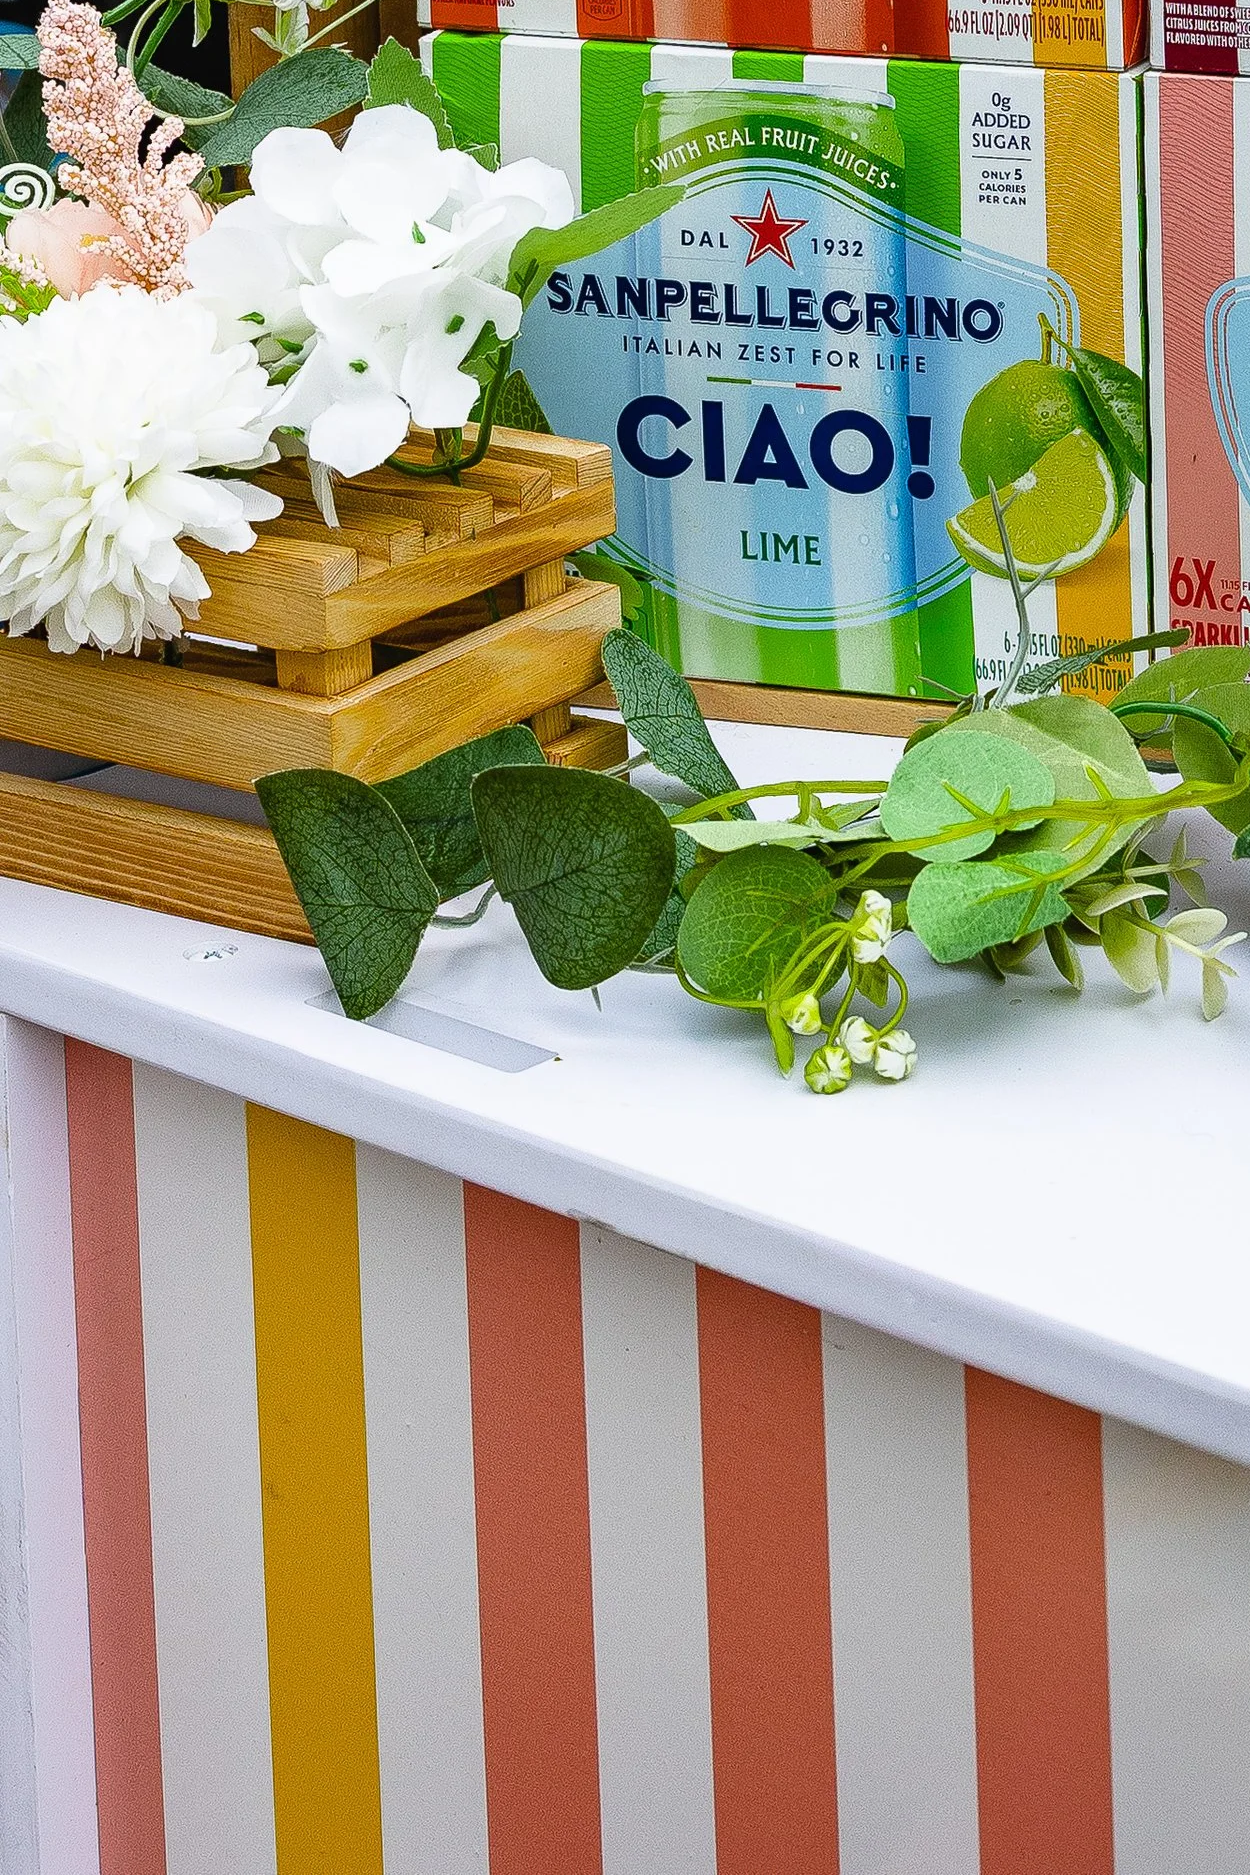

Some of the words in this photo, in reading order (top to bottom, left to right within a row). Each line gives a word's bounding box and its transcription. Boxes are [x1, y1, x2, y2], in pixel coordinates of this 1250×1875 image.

[1193, 4, 1218, 17] BLEND
[1219, 6, 1229, 18] OF
[971, 11, 980, 34] FL
[982, 11, 994, 35] OZ
[1072, 16, 1104, 47] TOTAL)
[1165, 17, 1193, 30] CITRUS
[1194, 19, 1219, 32] JUICES
[1220, 21, 1241, 34] FROM
[1166, 32, 1206, 45] FLAVORED
[1206, 35, 1227, 47] WITH
[992, 92, 1011, 112] 0g
[972, 112, 1031, 129] ADDED
[972, 133, 1031, 151] SUGAR
[650, 141, 701, 175] WITH
[705, 127, 755, 153] REAL
[761, 127, 819, 154] FRUIT
[822, 143, 890, 189] JUICES
[981, 170, 1011, 180] ONLY
[1014, 168, 1023, 181] 5
[979, 183, 1026, 193] CALORIES
[979, 195, 1000, 204] PER
[1003, 196, 1026, 206] CAN
[681, 230, 729, 249] DAL
[810, 237, 863, 257] 1932
[623, 335, 722, 360] ITALIAN
[738, 344, 796, 365] ZEST
[812, 350, 860, 369] FOR
[876, 354, 927, 374] LIFE
[616, 393, 935, 500] CIAO!
[740, 530, 822, 566] LIME
[1170, 557, 1217, 610] 6X
[1039, 634, 1049, 656] FL
